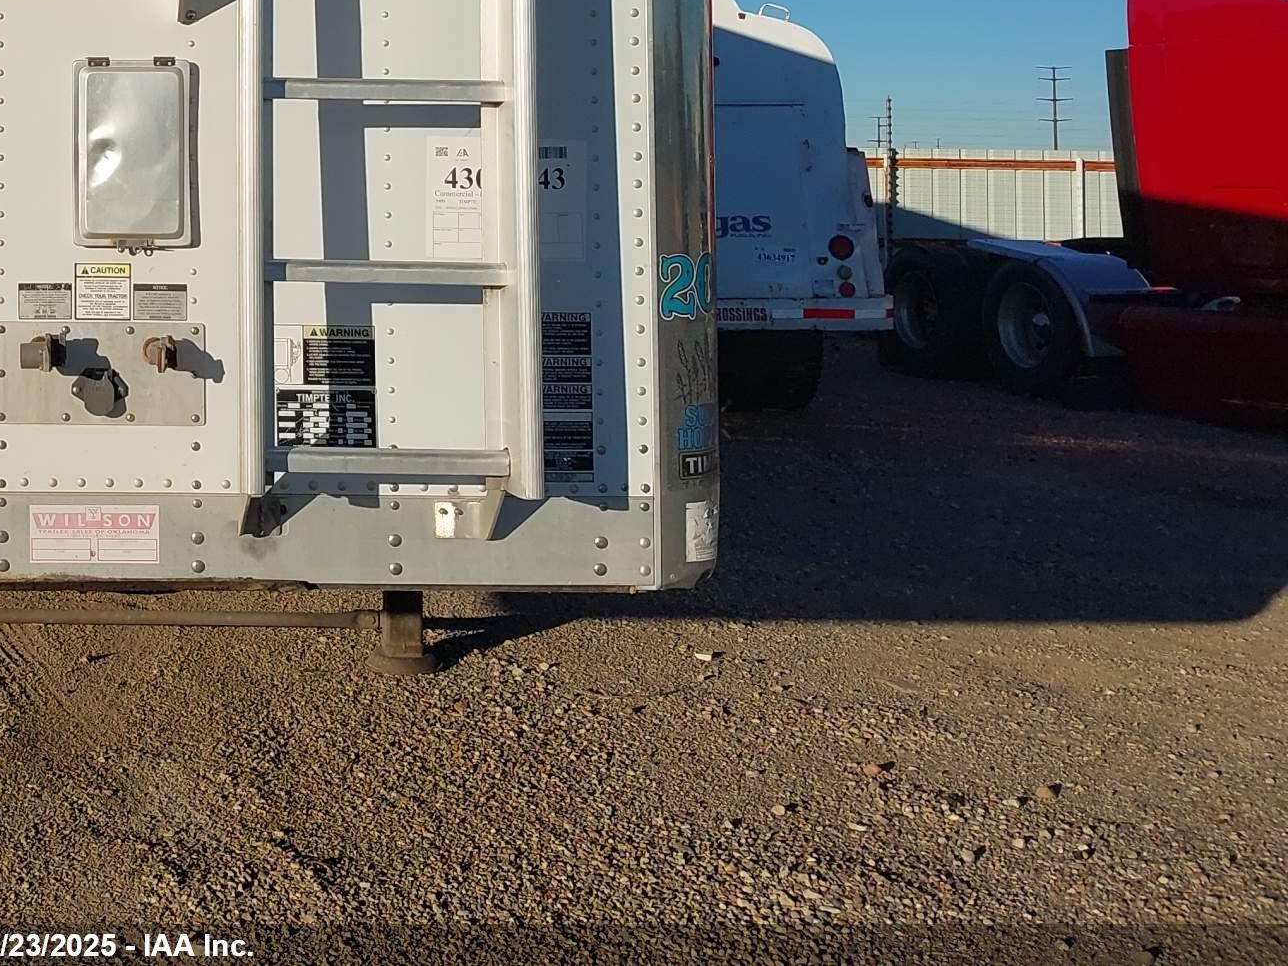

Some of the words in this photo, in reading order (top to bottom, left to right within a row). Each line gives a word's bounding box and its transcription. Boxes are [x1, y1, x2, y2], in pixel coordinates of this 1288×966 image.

[90, 265, 126, 275] CAUTION
[543, 313, 586, 323] ARNING
[319, 328, 370, 338] WARNING
[543, 357, 587, 367] ARNING
[543, 384, 588, 394] ARNING
[295, 393, 331, 403] TIMPTE
[335, 393, 356, 403] INC.
[37, 513, 152, 528] WILSON
